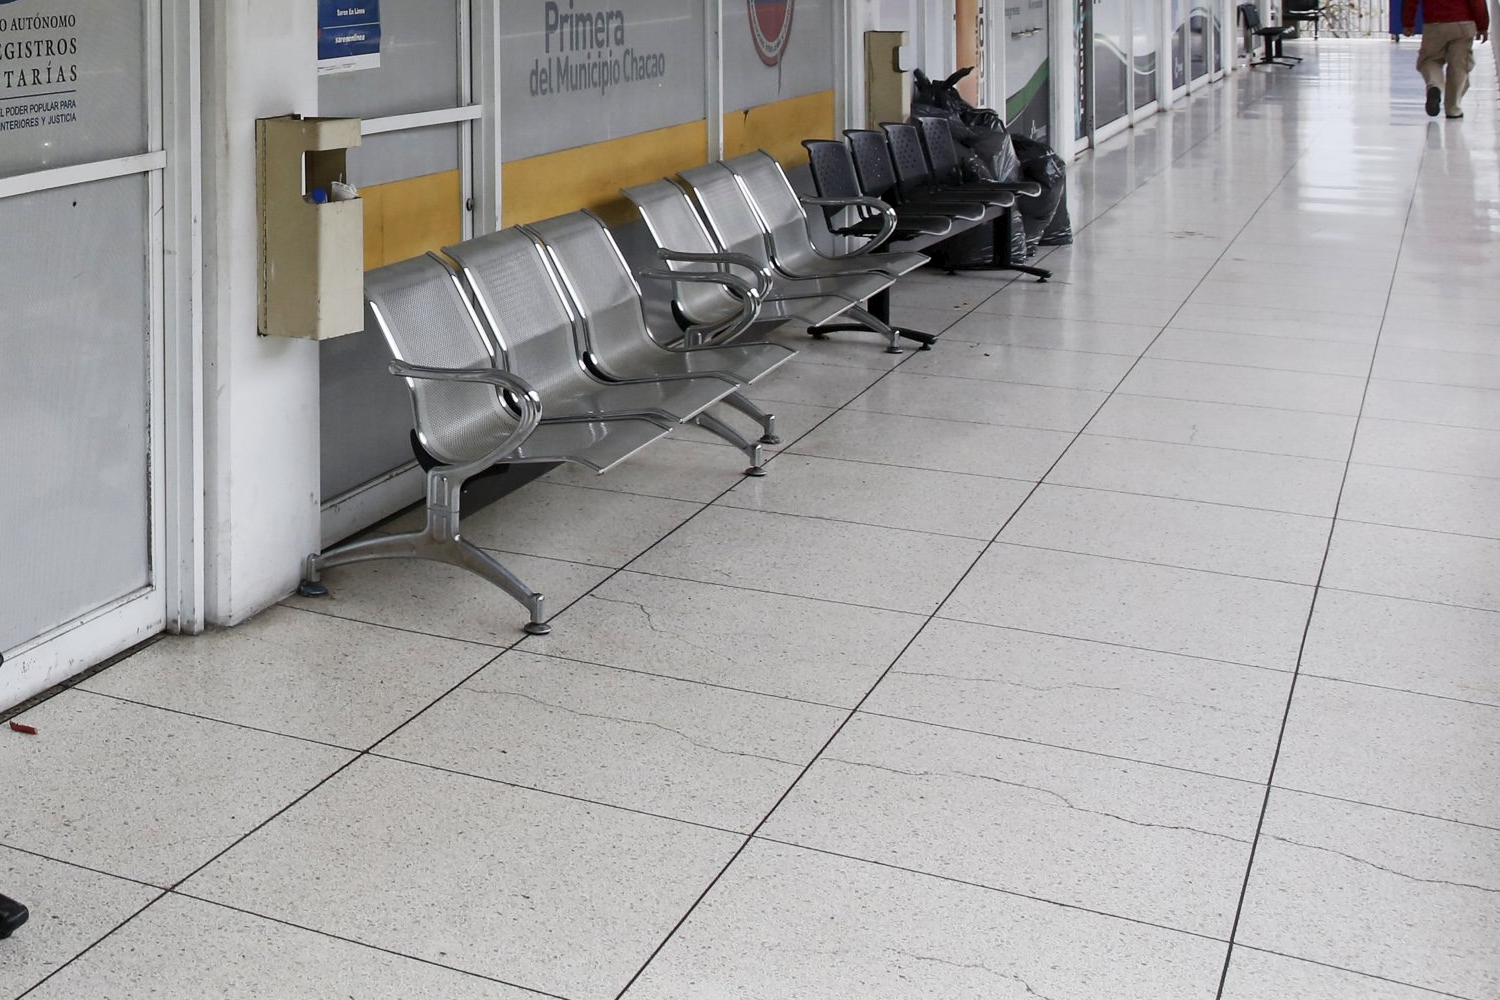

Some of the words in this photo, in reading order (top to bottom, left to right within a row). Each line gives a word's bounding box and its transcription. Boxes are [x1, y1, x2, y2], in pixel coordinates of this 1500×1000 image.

[10, 11, 76, 32] AUTÓNOMO
[529, 56, 552, 97] del
[557, 52, 620, 96] Municipio
[623, 47, 665, 85] Chacao
[5, 105, 29, 118] PODER
[30, 102, 59, 115] POPULAR
[60, 99, 76, 112] PARA
[41, 116, 46, 127] Y
[48, 112, 76, 126] JUSTICIA
